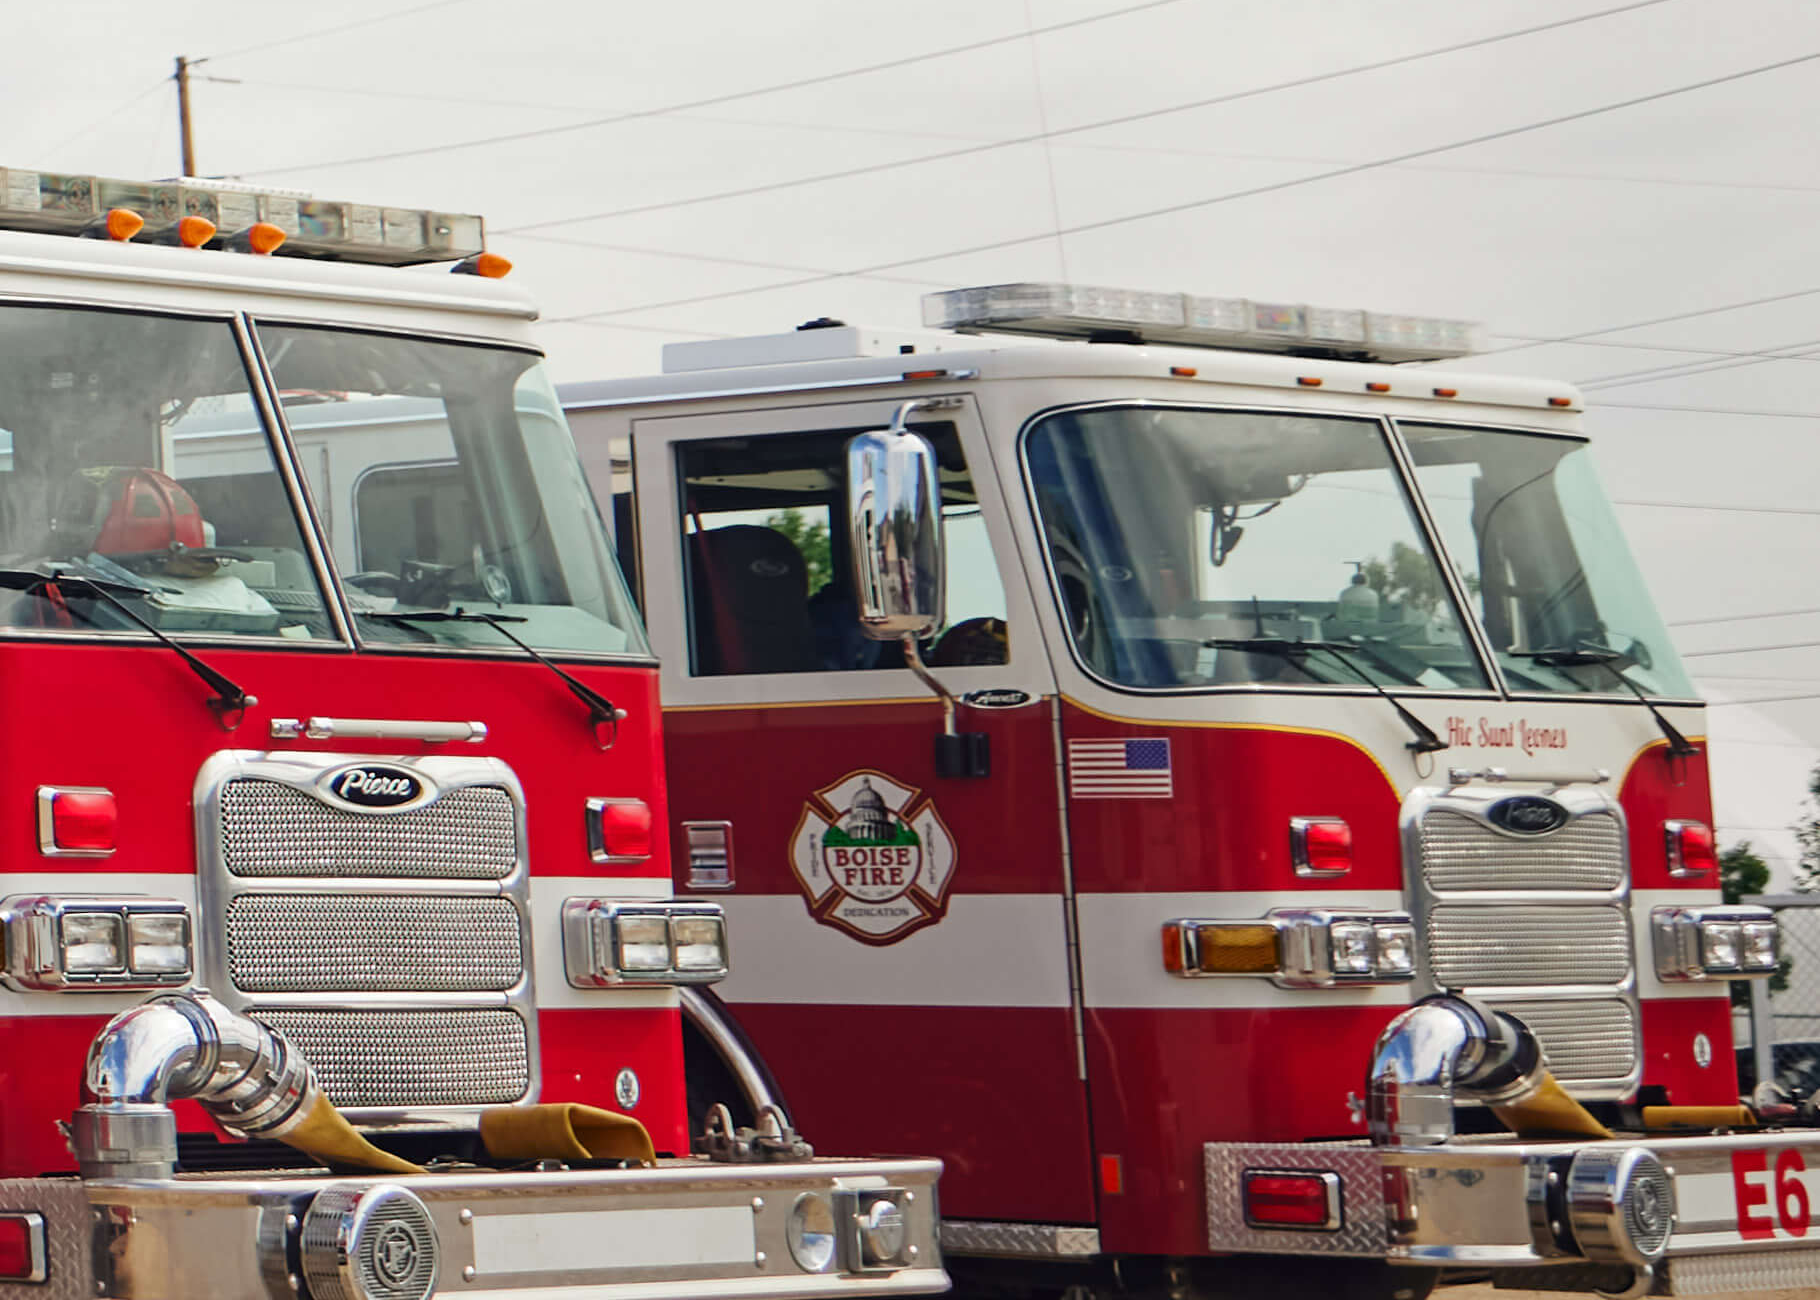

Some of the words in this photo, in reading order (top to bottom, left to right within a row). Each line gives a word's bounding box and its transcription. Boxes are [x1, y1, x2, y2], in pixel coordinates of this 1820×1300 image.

[340, 769, 412, 798] Pierce
[834, 848, 912, 867] BOISE
[843, 867, 905, 886] FIRE
[1731, 1148, 1810, 1241] E6
